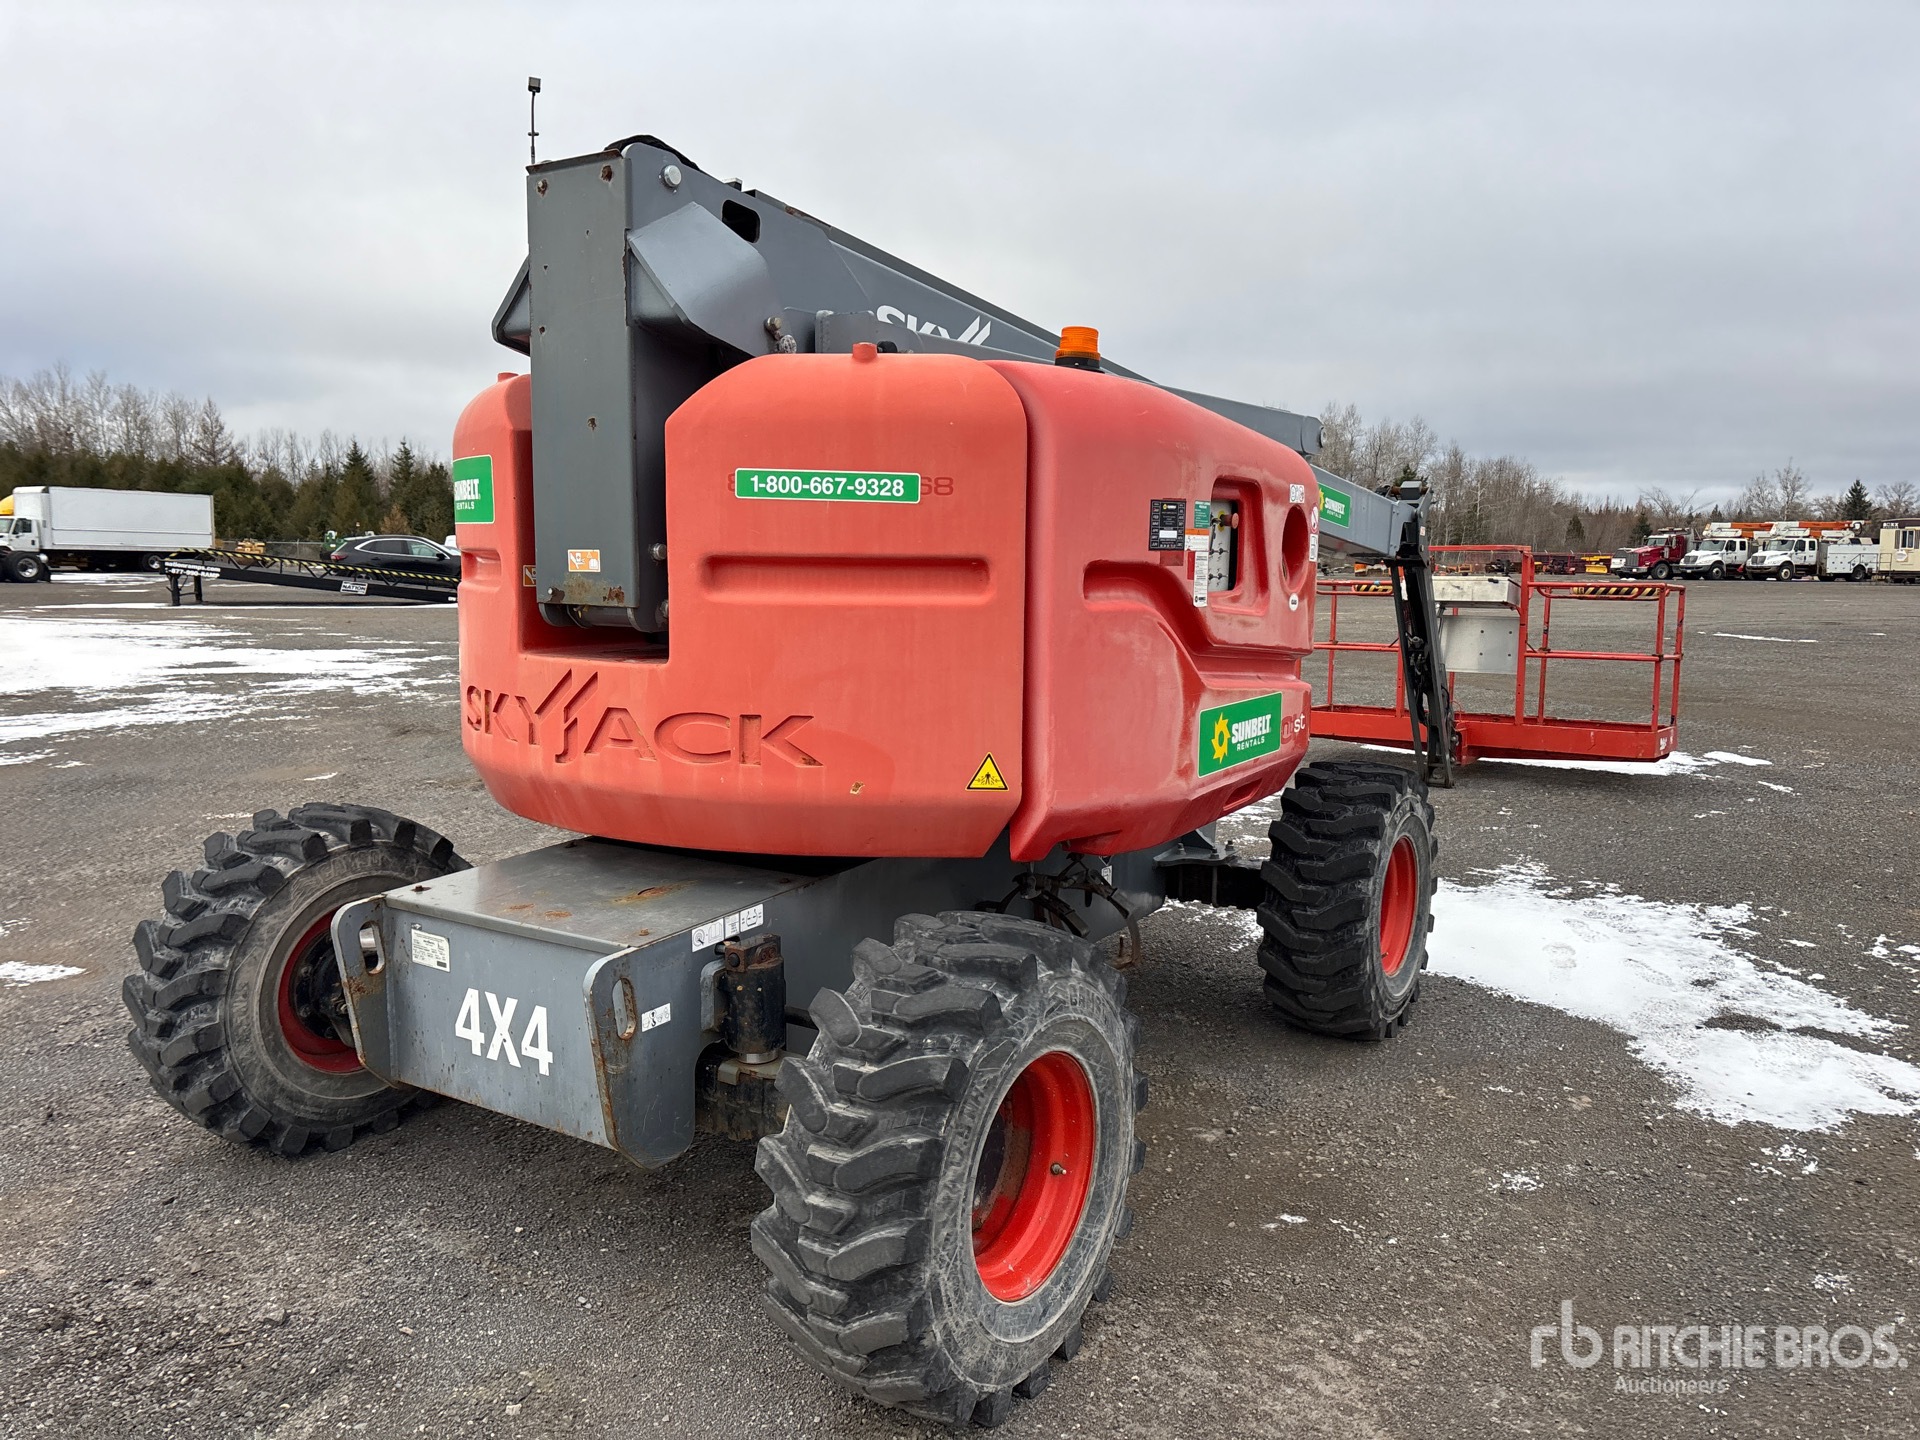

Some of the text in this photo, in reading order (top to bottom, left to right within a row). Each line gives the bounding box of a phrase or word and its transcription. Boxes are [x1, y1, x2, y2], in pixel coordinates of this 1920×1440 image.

[749, 475, 905, 497] 1-800-667-9328
[465, 668, 825, 768] SKYJACK
[1231, 714, 1271, 744] SUNBELT
[1236, 736, 1265, 752] RENTALS
[455, 987, 554, 1077] 4X4
